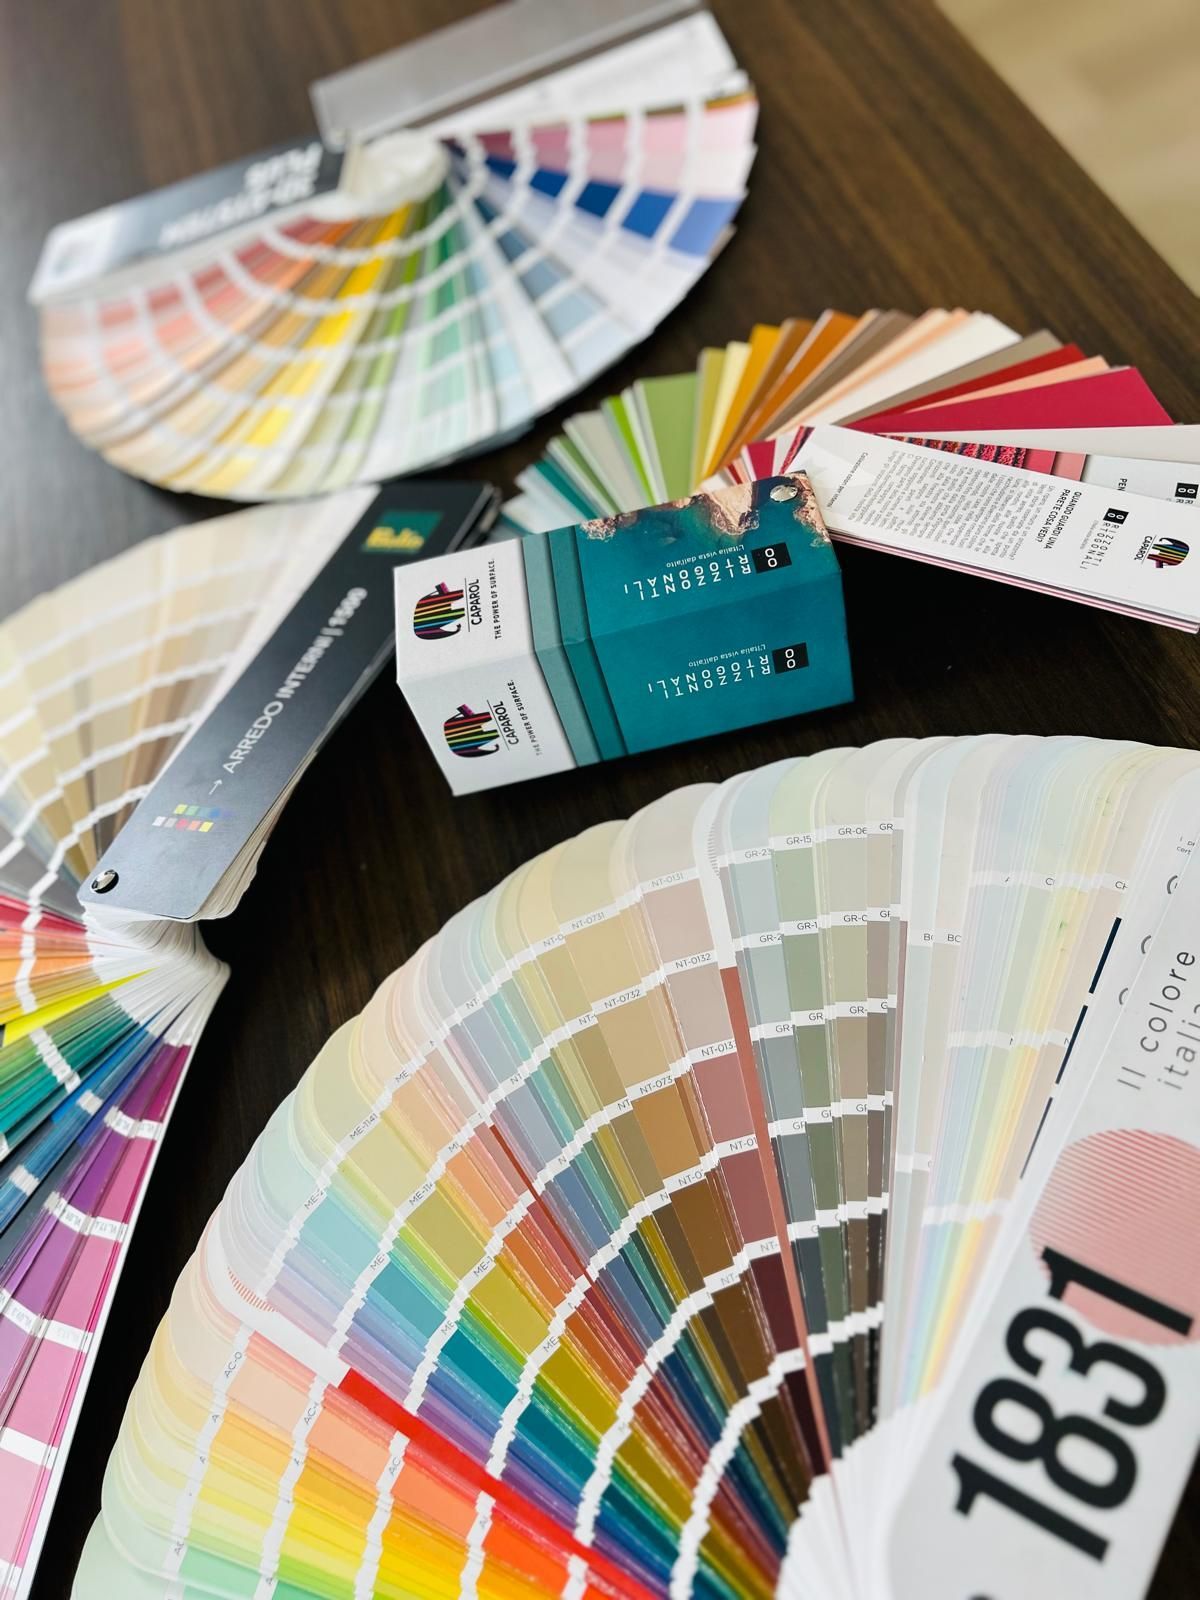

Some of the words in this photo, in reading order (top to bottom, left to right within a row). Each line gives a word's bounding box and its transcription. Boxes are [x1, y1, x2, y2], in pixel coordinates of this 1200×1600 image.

[1053, 488, 1070, 510] PARETE
[1063, 491, 1082, 515] QUANDO
[699, 549, 717, 560] vista
[1134, 536, 1153, 561] CAPAROL
[468, 578, 482, 626] CAPAROL
[491, 592, 498, 601] OF
[491, 602, 500, 624] POWER
[494, 624, 502, 640] THE
[721, 651, 739, 660] vista
[222, 701, 284, 774] ARREDO
[275, 635, 334, 699] INTERNI
[507, 680, 525, 711] SURFACE.
[493, 701, 520, 745] CAPAROL
[520, 712, 528, 721] OF
[524, 721, 536, 743] POWER
[786, 836, 812, 845] GR-15
[651, 873, 684, 888] NT-0131
[571, 912, 605, 930] NT-0731
[675, 953, 711, 969] NT-0132
[604, 989, 641, 1009] NT-0732
[1140, 951, 1195, 1053] colore
[640, 1075, 673, 1095] NT-073
[350, 1113, 378, 1141] ME-1141
[950, 1245, 1194, 1564] 1831
